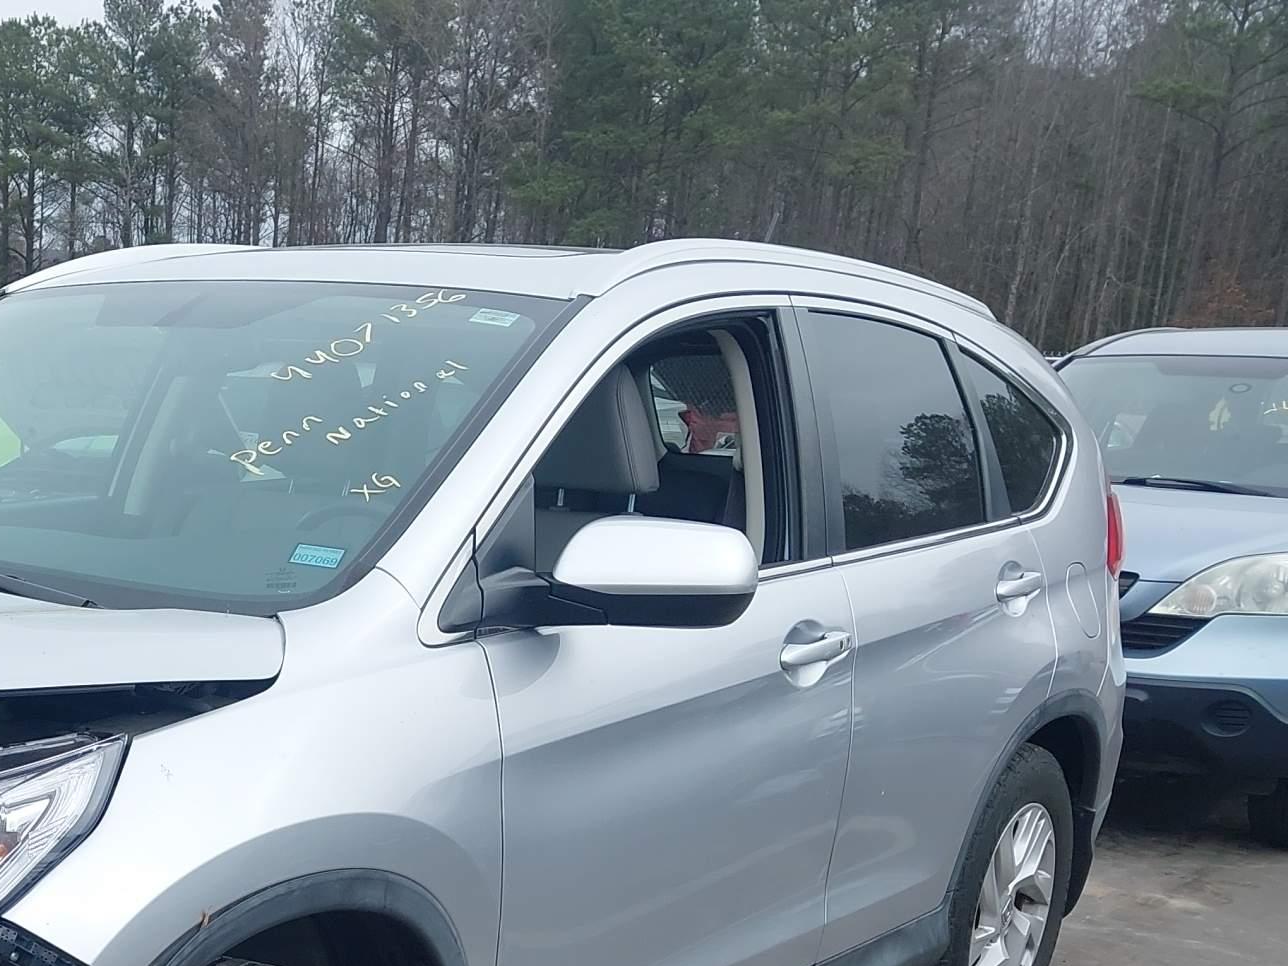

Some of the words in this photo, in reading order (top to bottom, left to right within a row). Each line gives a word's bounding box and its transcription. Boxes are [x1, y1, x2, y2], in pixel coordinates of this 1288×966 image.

[271, 289, 467, 381] 44071356
[229, 415, 323, 476] Penn
[350, 472, 402, 502] XG
